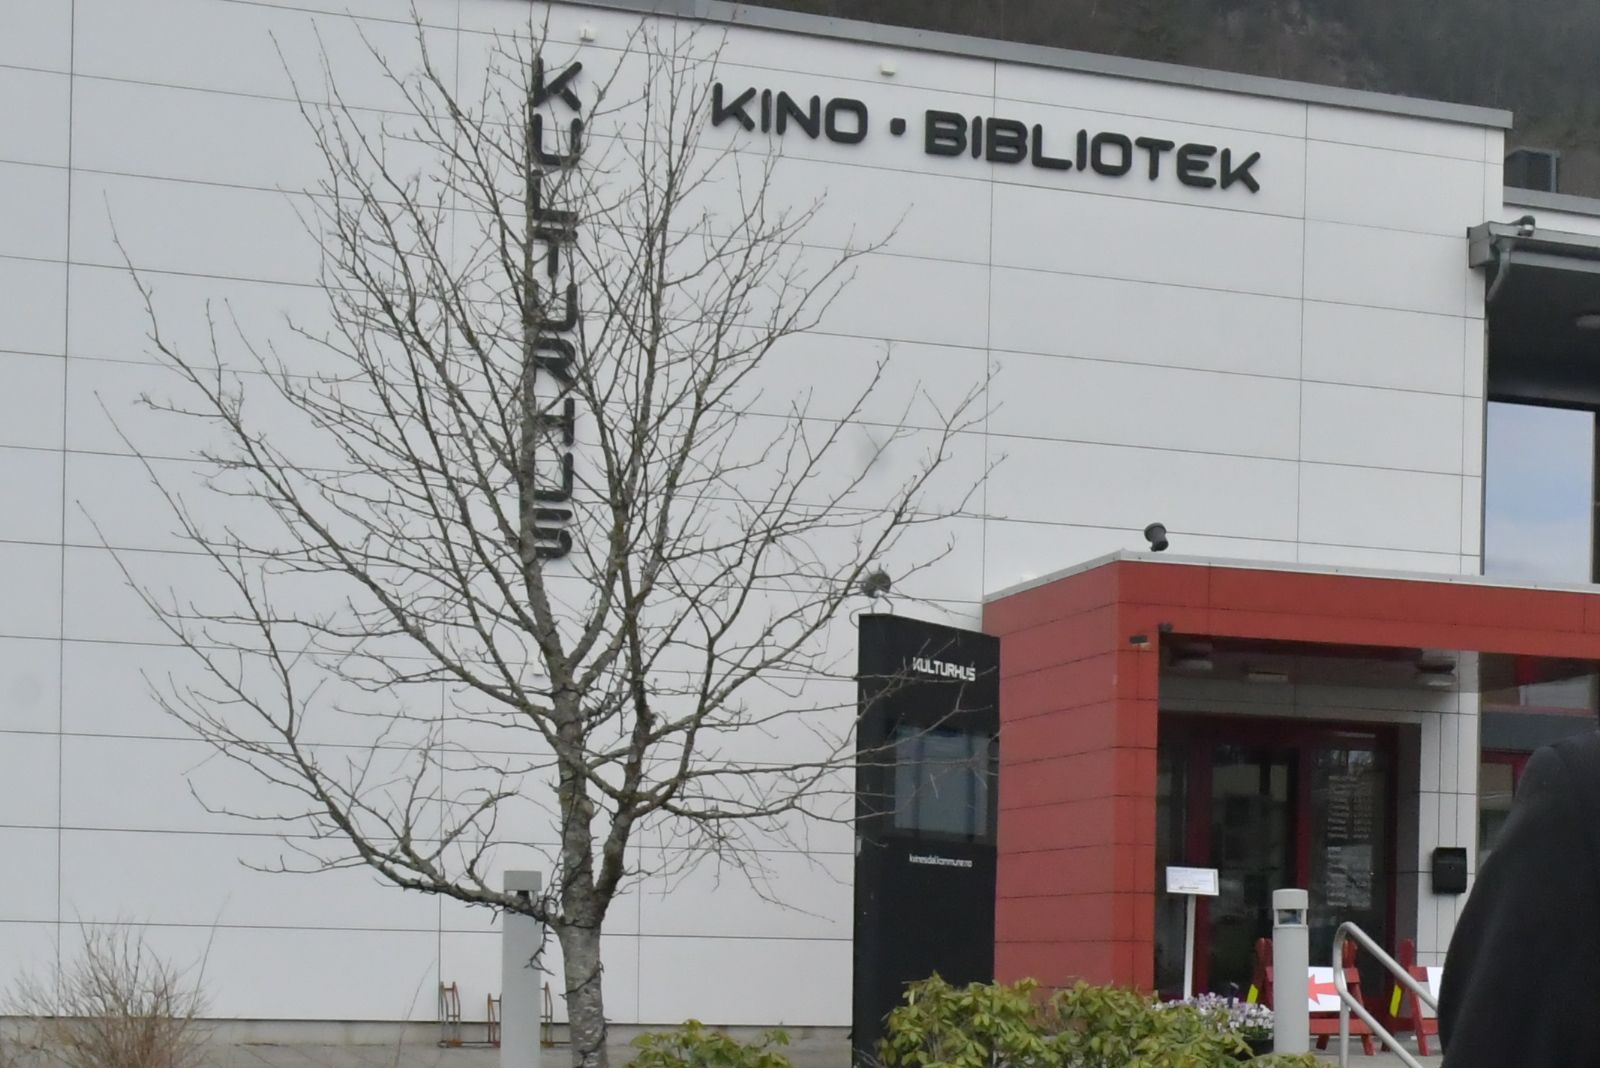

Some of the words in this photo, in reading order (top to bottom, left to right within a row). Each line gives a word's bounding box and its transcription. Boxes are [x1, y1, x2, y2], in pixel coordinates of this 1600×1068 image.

[711, 82, 868, 144] KINO
[925, 109, 1261, 193] BIBLIOTEK
[531, 56, 583, 558] KULTURHUS
[912, 656, 976, 682] KULTURHUS
